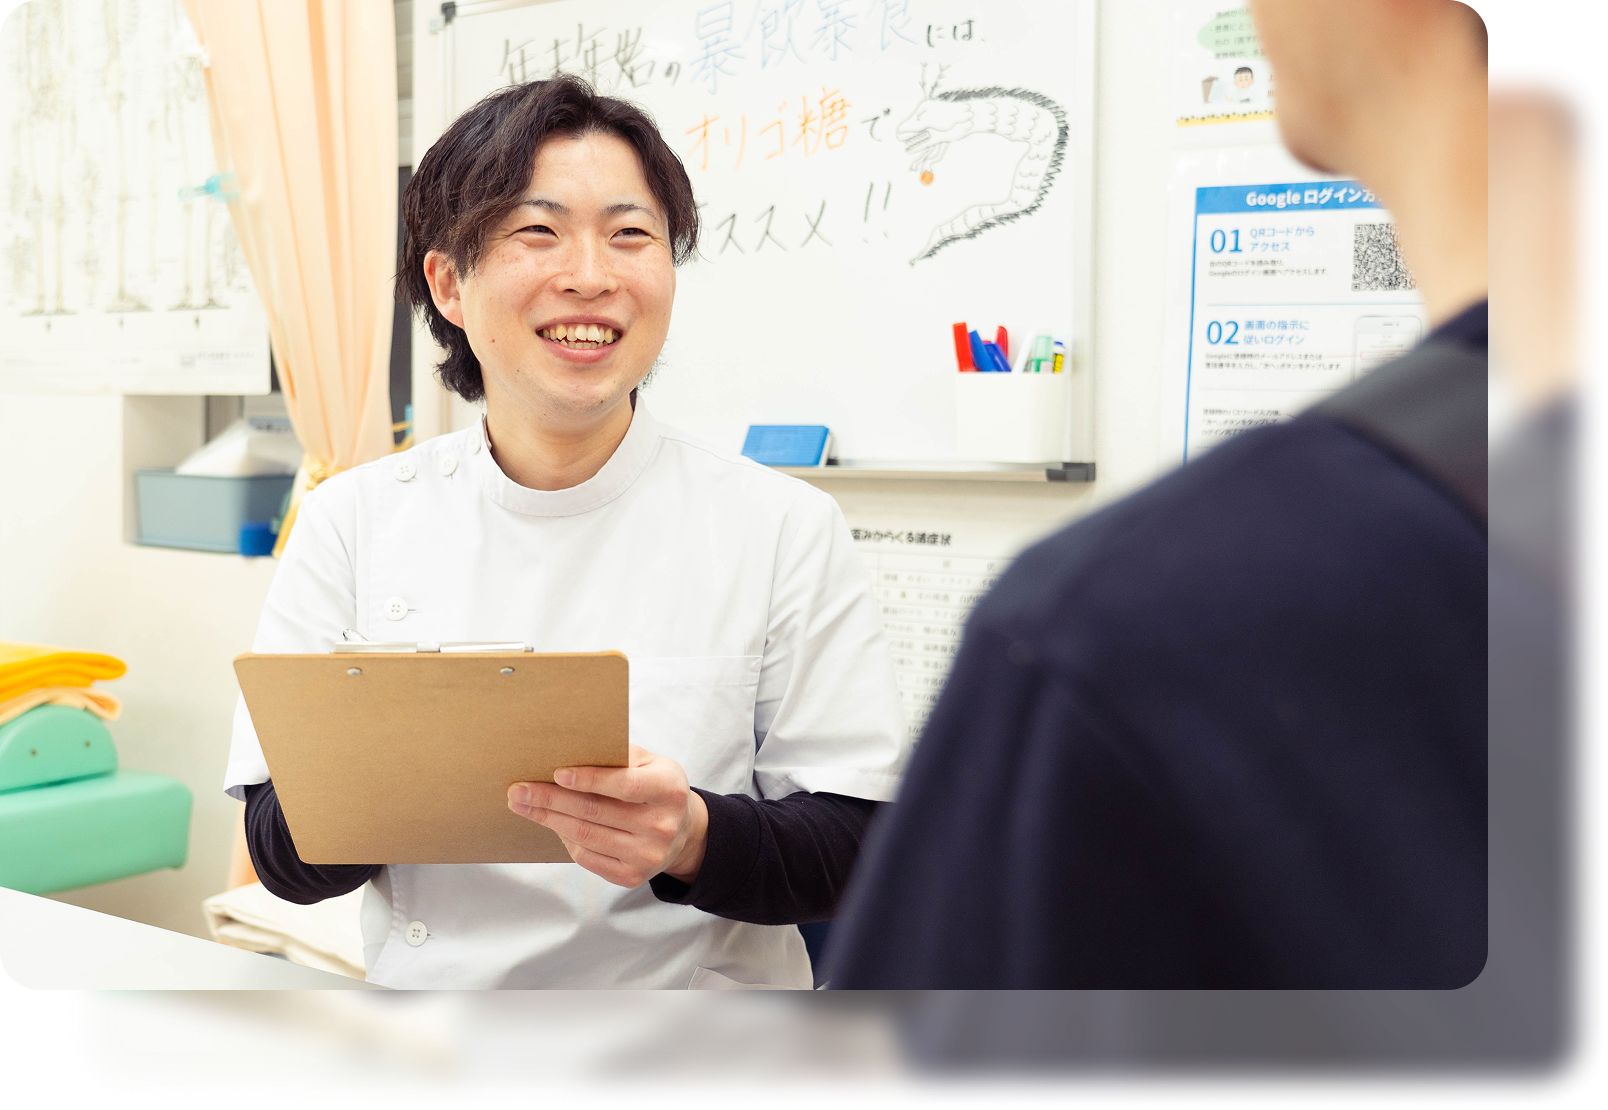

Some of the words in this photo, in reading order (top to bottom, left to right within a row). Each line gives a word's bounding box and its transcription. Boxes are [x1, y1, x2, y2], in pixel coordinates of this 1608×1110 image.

[1246, 190, 1301, 209] Google
[1303, 187, 1384, 205] ログイン方
[694, 181, 892, 256] ススメ!!
[1250, 226, 1315, 239] QRコードから
[1210, 229, 1243, 254] 01
[1250, 242, 1290, 253] アクセス
[1207, 321, 1239, 345] 02
[1244, 320, 1310, 331] 画面の指示に
[1243, 335, 1305, 346] 従いログイン
